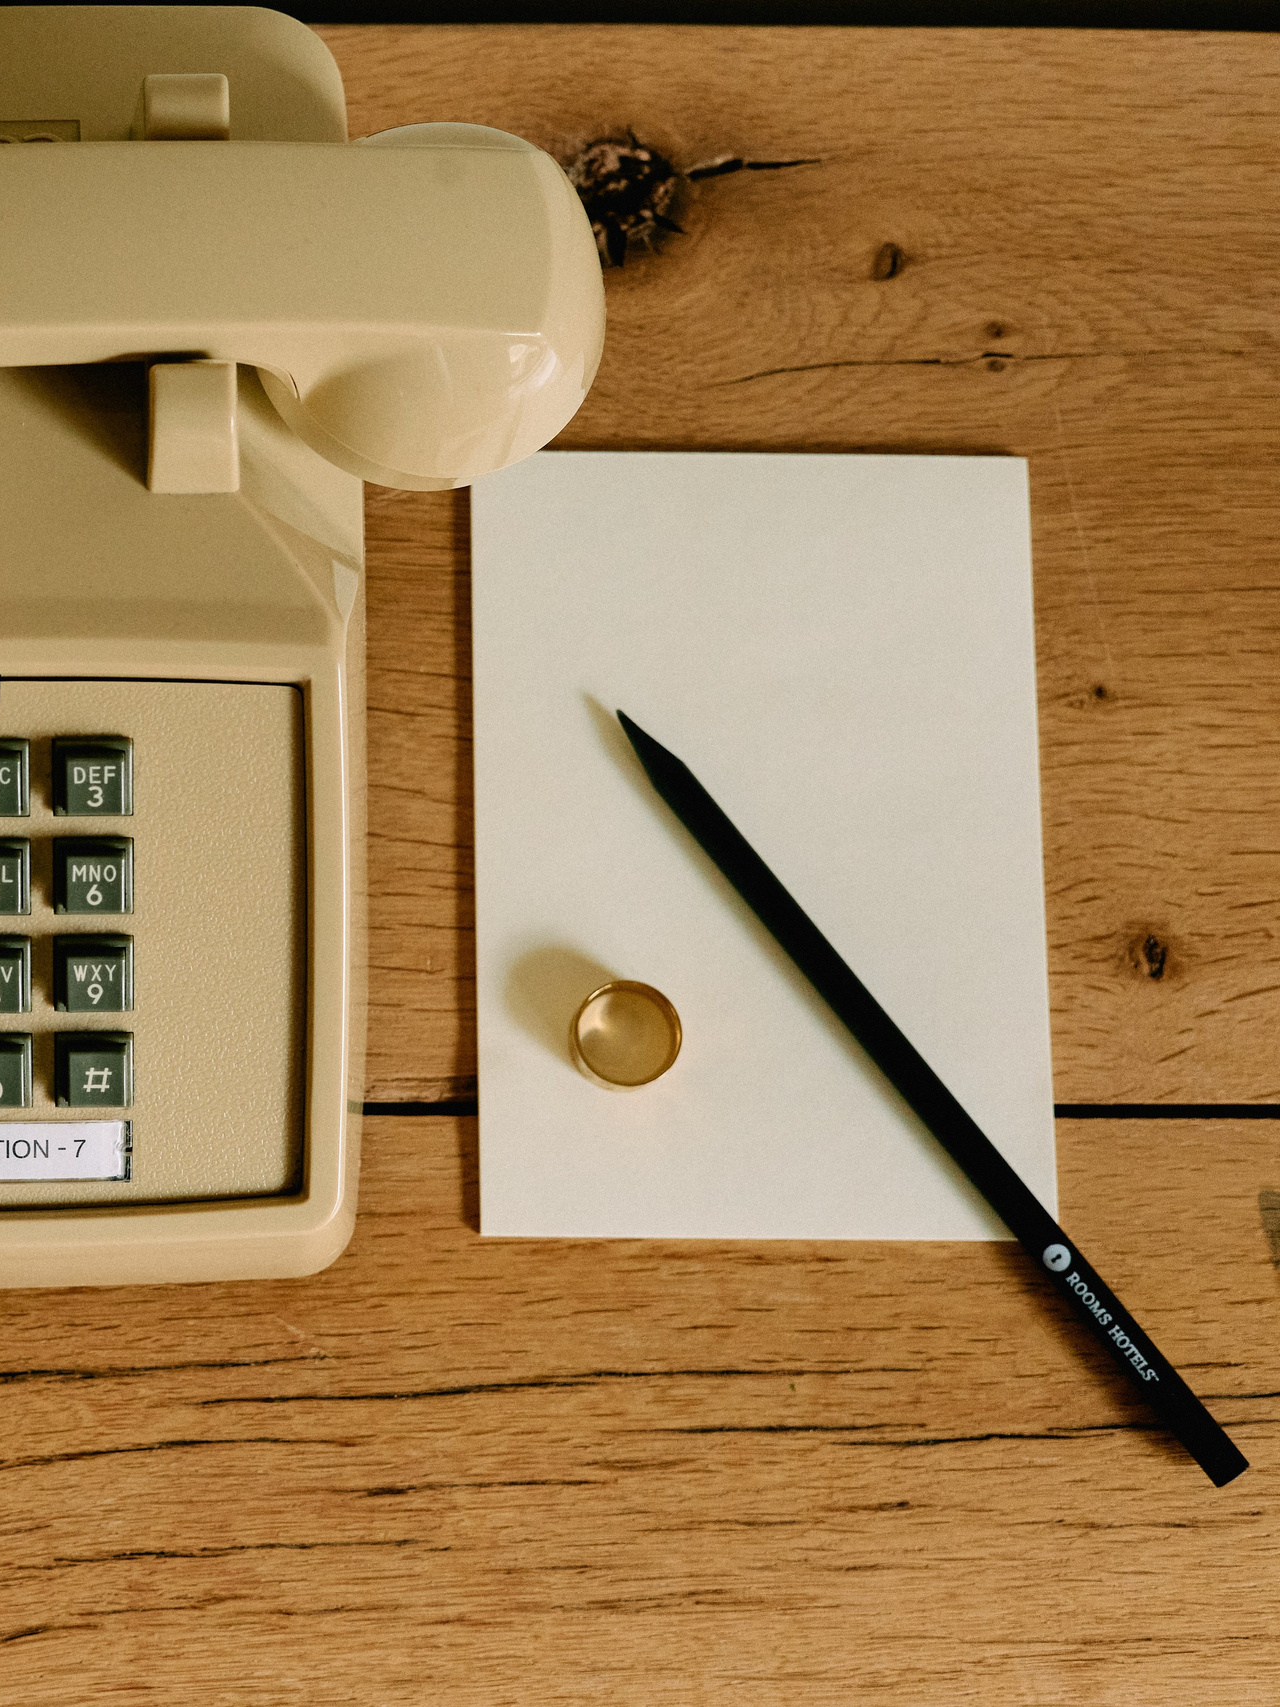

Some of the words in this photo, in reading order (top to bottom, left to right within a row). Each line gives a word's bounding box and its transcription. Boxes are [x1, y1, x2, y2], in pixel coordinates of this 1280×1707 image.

[73, 765, 117, 785] DEF
[86, 785, 104, 808] 3
[71, 864, 117, 883] MNO
[86, 884, 103, 906] 6
[73, 964, 117, 982] WXY
[86, 983, 104, 1005] 9
[73, 1139, 87, 1158] 7
[1065, 1271, 1112, 1325] ROOMS
